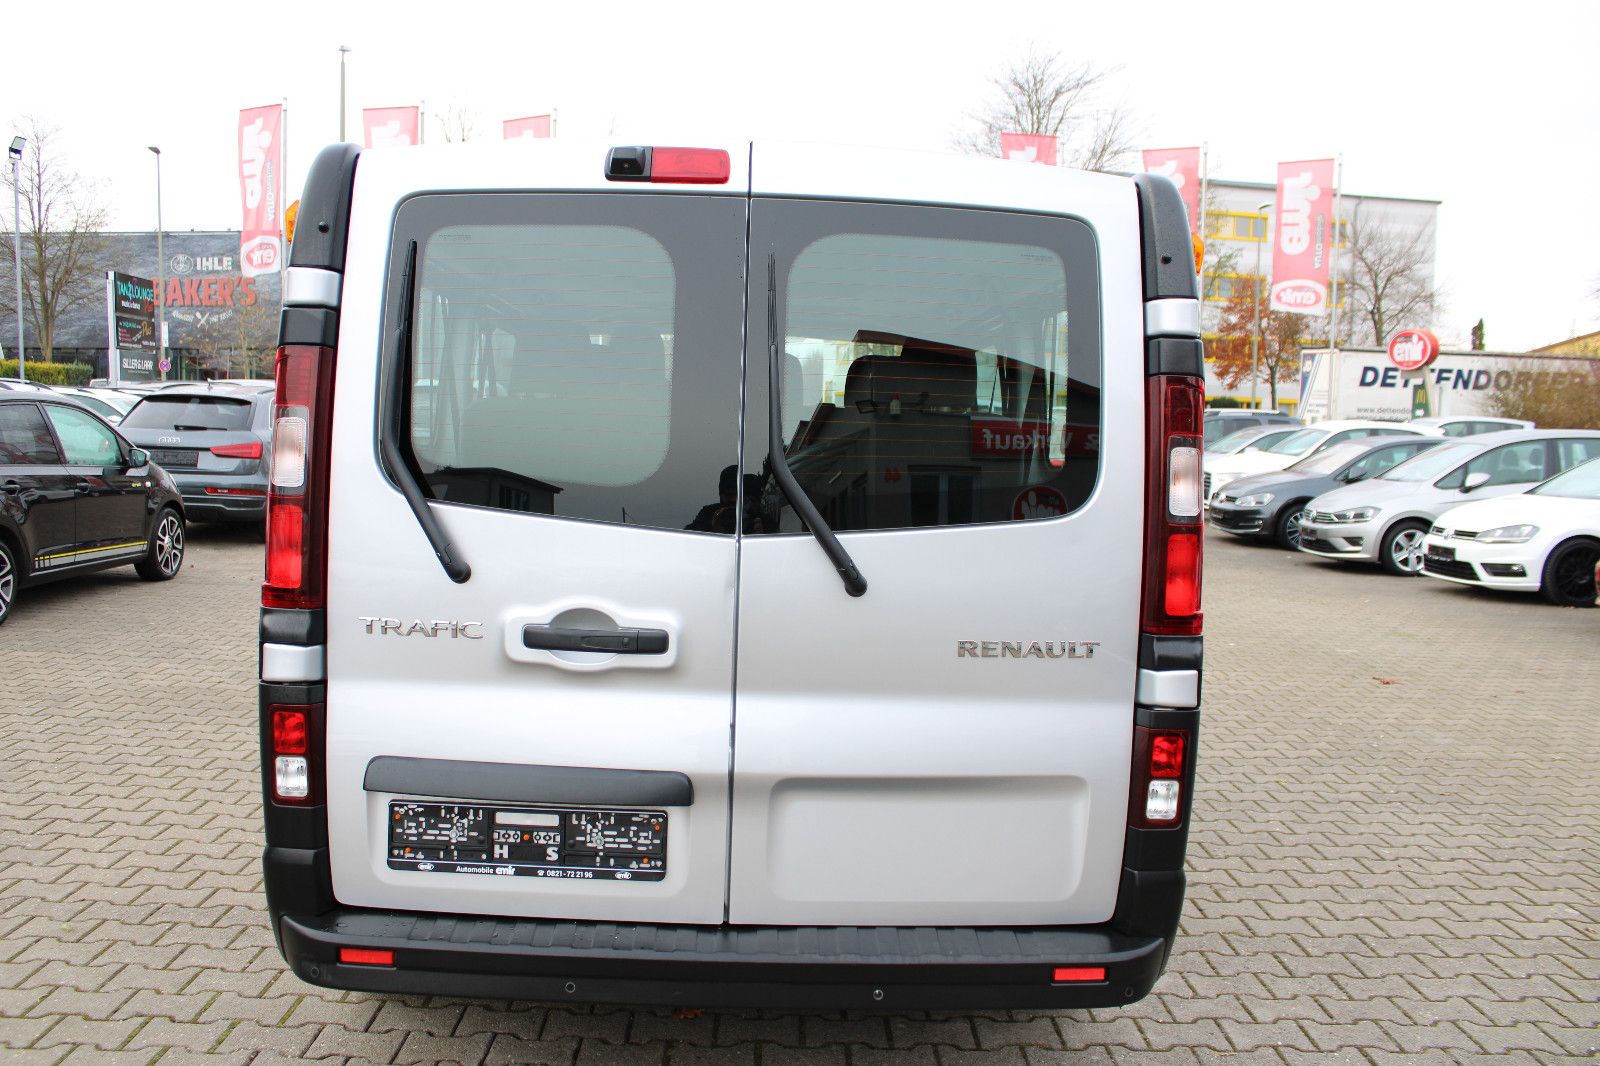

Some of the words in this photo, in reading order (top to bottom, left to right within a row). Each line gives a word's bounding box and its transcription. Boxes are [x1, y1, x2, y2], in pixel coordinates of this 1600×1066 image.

[196, 256, 233, 271] IHLE
[153, 277, 256, 307] BAKER'S
[1393, 334, 1424, 361] emir
[358, 616, 483, 640] TRAFIC
[956, 639, 1101, 659] RENAULT
[455, 865, 494, 874] Automobile
[495, 865, 516, 875] emir
